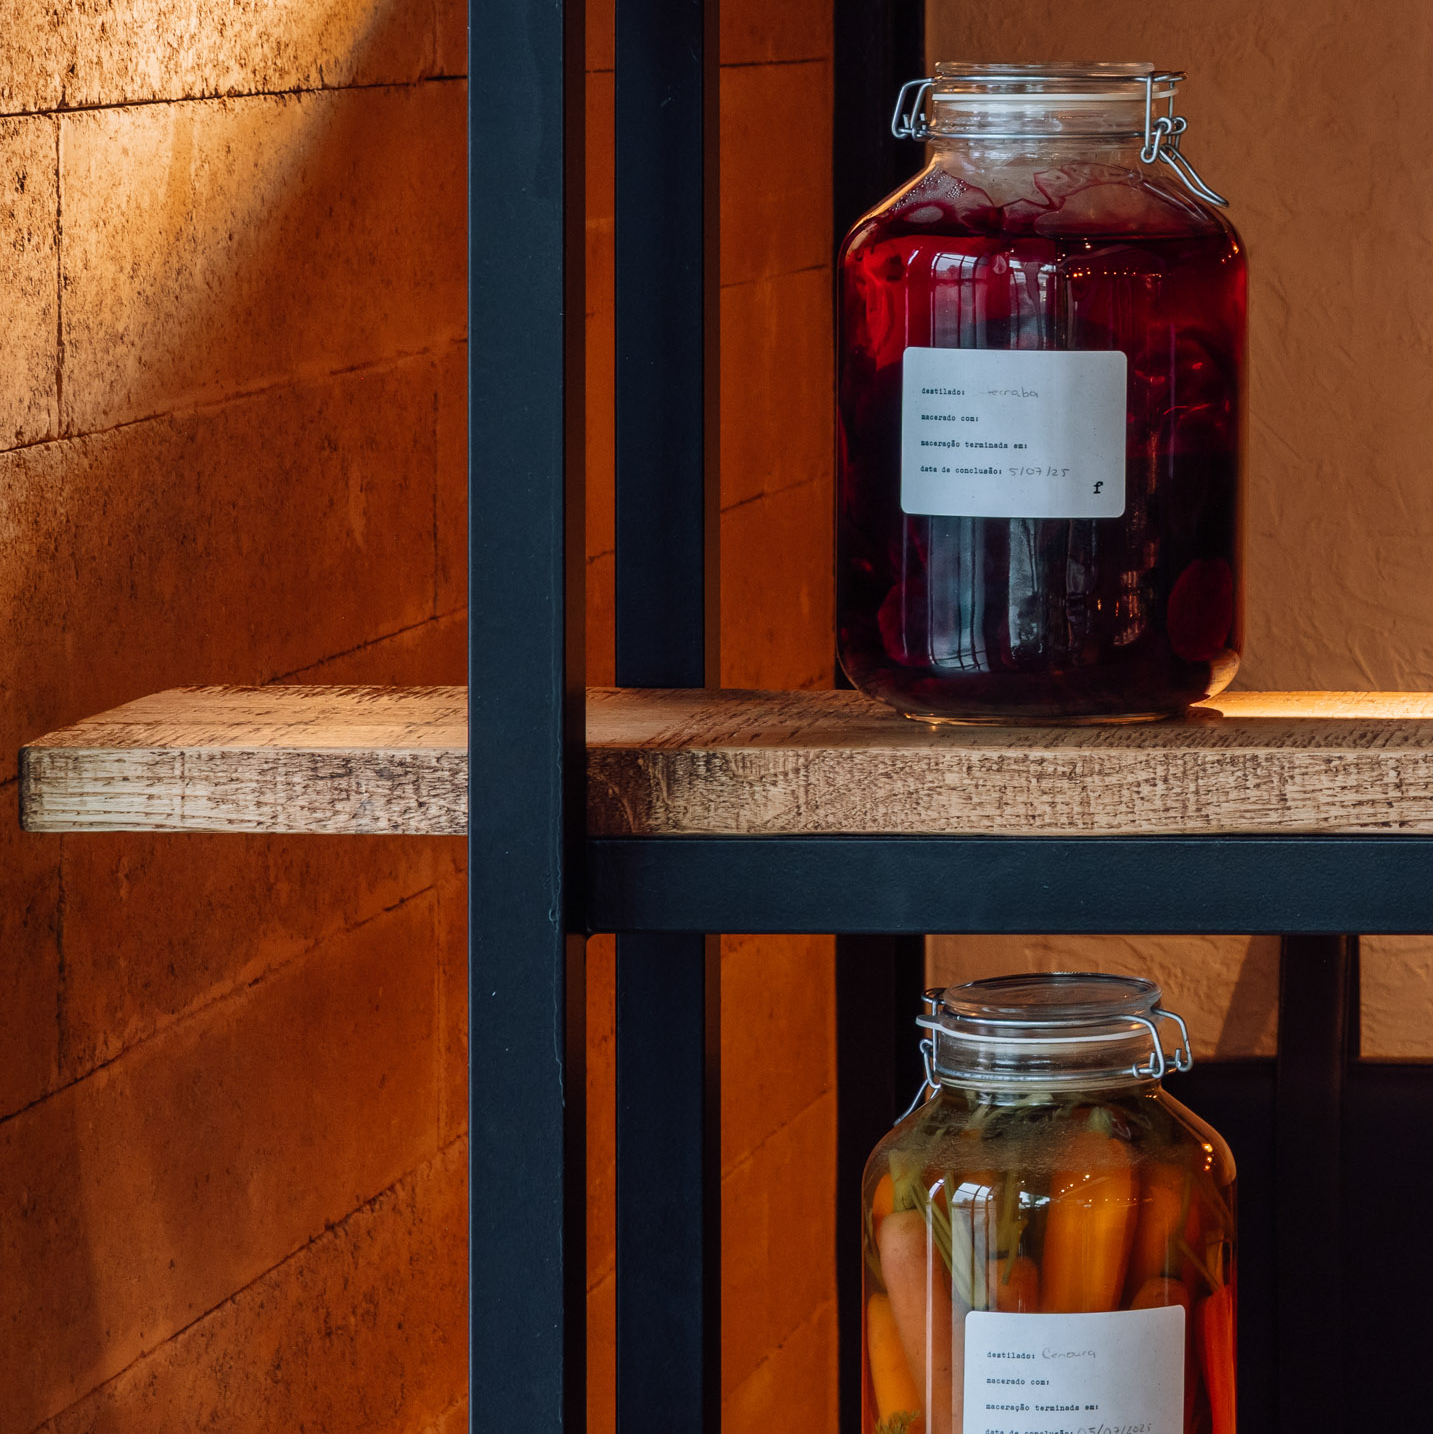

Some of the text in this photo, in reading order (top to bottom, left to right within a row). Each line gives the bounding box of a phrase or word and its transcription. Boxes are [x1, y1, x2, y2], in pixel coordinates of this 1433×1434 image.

[921, 387, 966, 396] destilado:
[920, 413, 979, 423] macerado com:
[920, 439, 1028, 450] maceração terminada em:
[919, 464, 938, 473] data
[941, 466, 951, 474] de
[954, 466, 1003, 475] conclusão:
[1092, 480, 1105, 495] f
[986, 1350, 1036, 1360] destilado:
[985, 1377, 1026, 1386] macerado
[985, 1402, 1031, 1413] maceração
[1034, 1403, 1080, 1412] terminada
